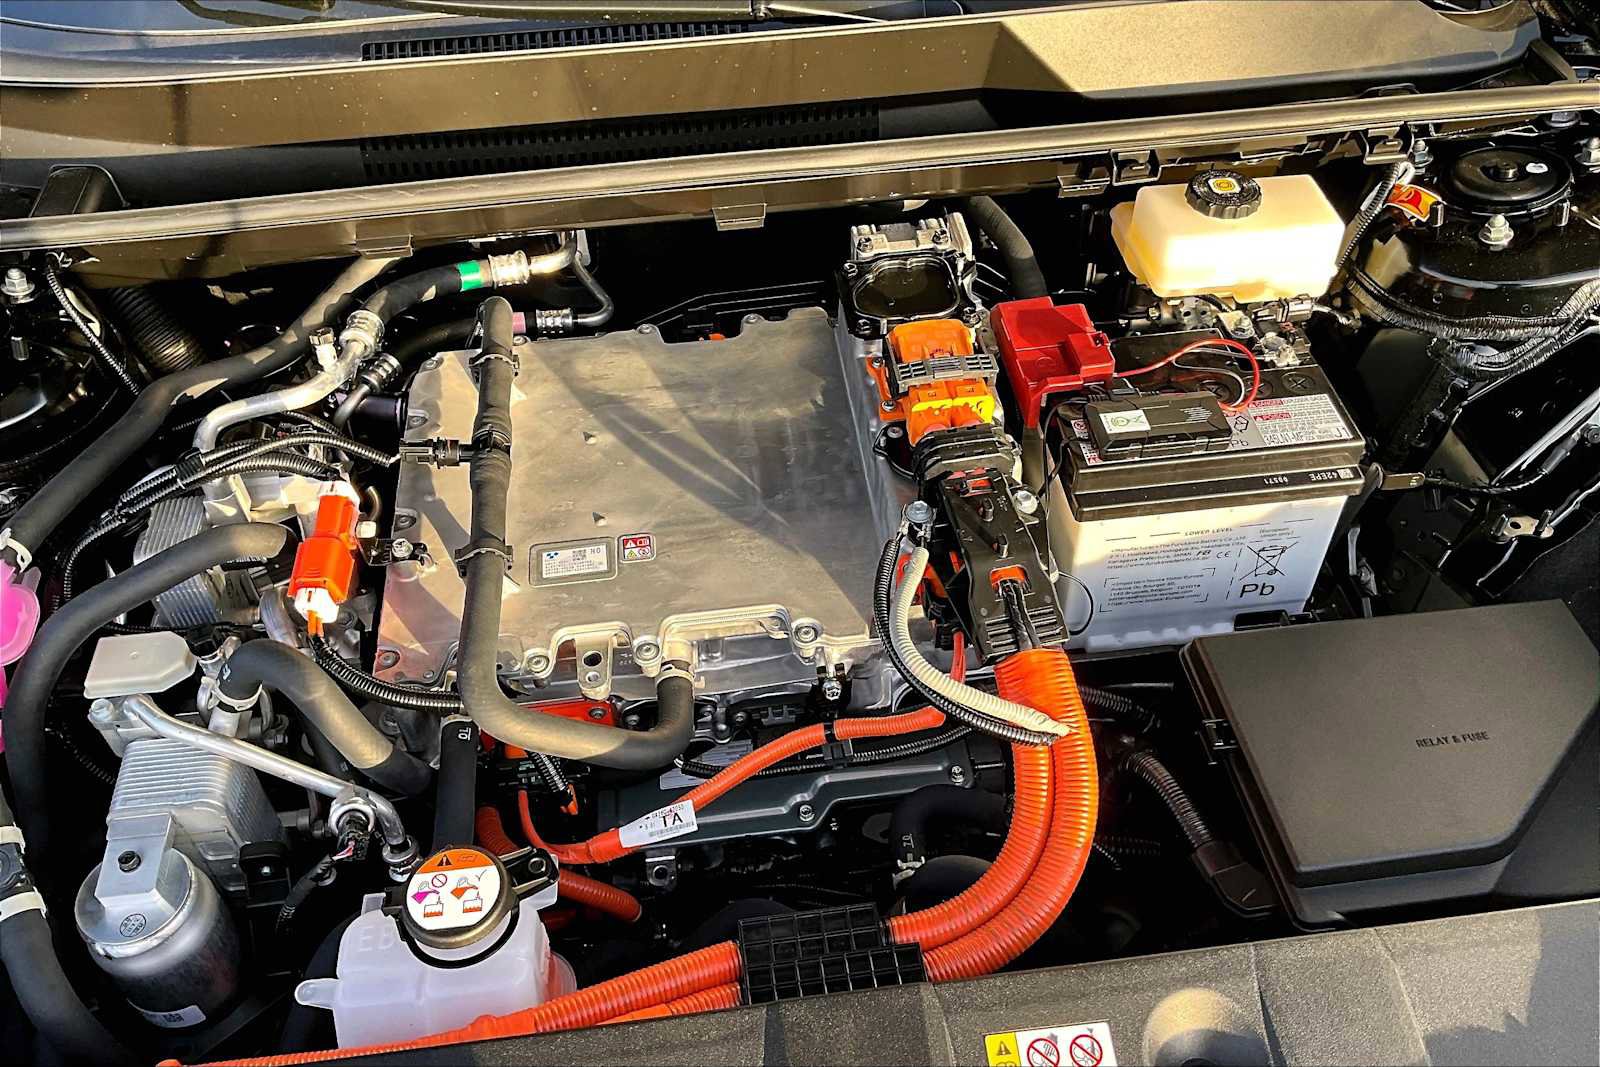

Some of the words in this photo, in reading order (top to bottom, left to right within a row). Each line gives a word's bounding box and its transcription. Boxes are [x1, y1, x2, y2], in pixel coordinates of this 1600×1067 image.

[1231, 439, 1249, 449] Pb
[1239, 581, 1276, 599] Pb
[1415, 736, 1450, 748] RELAY
[1461, 731, 1491, 743] FUSE
[661, 811, 685, 828] TA
